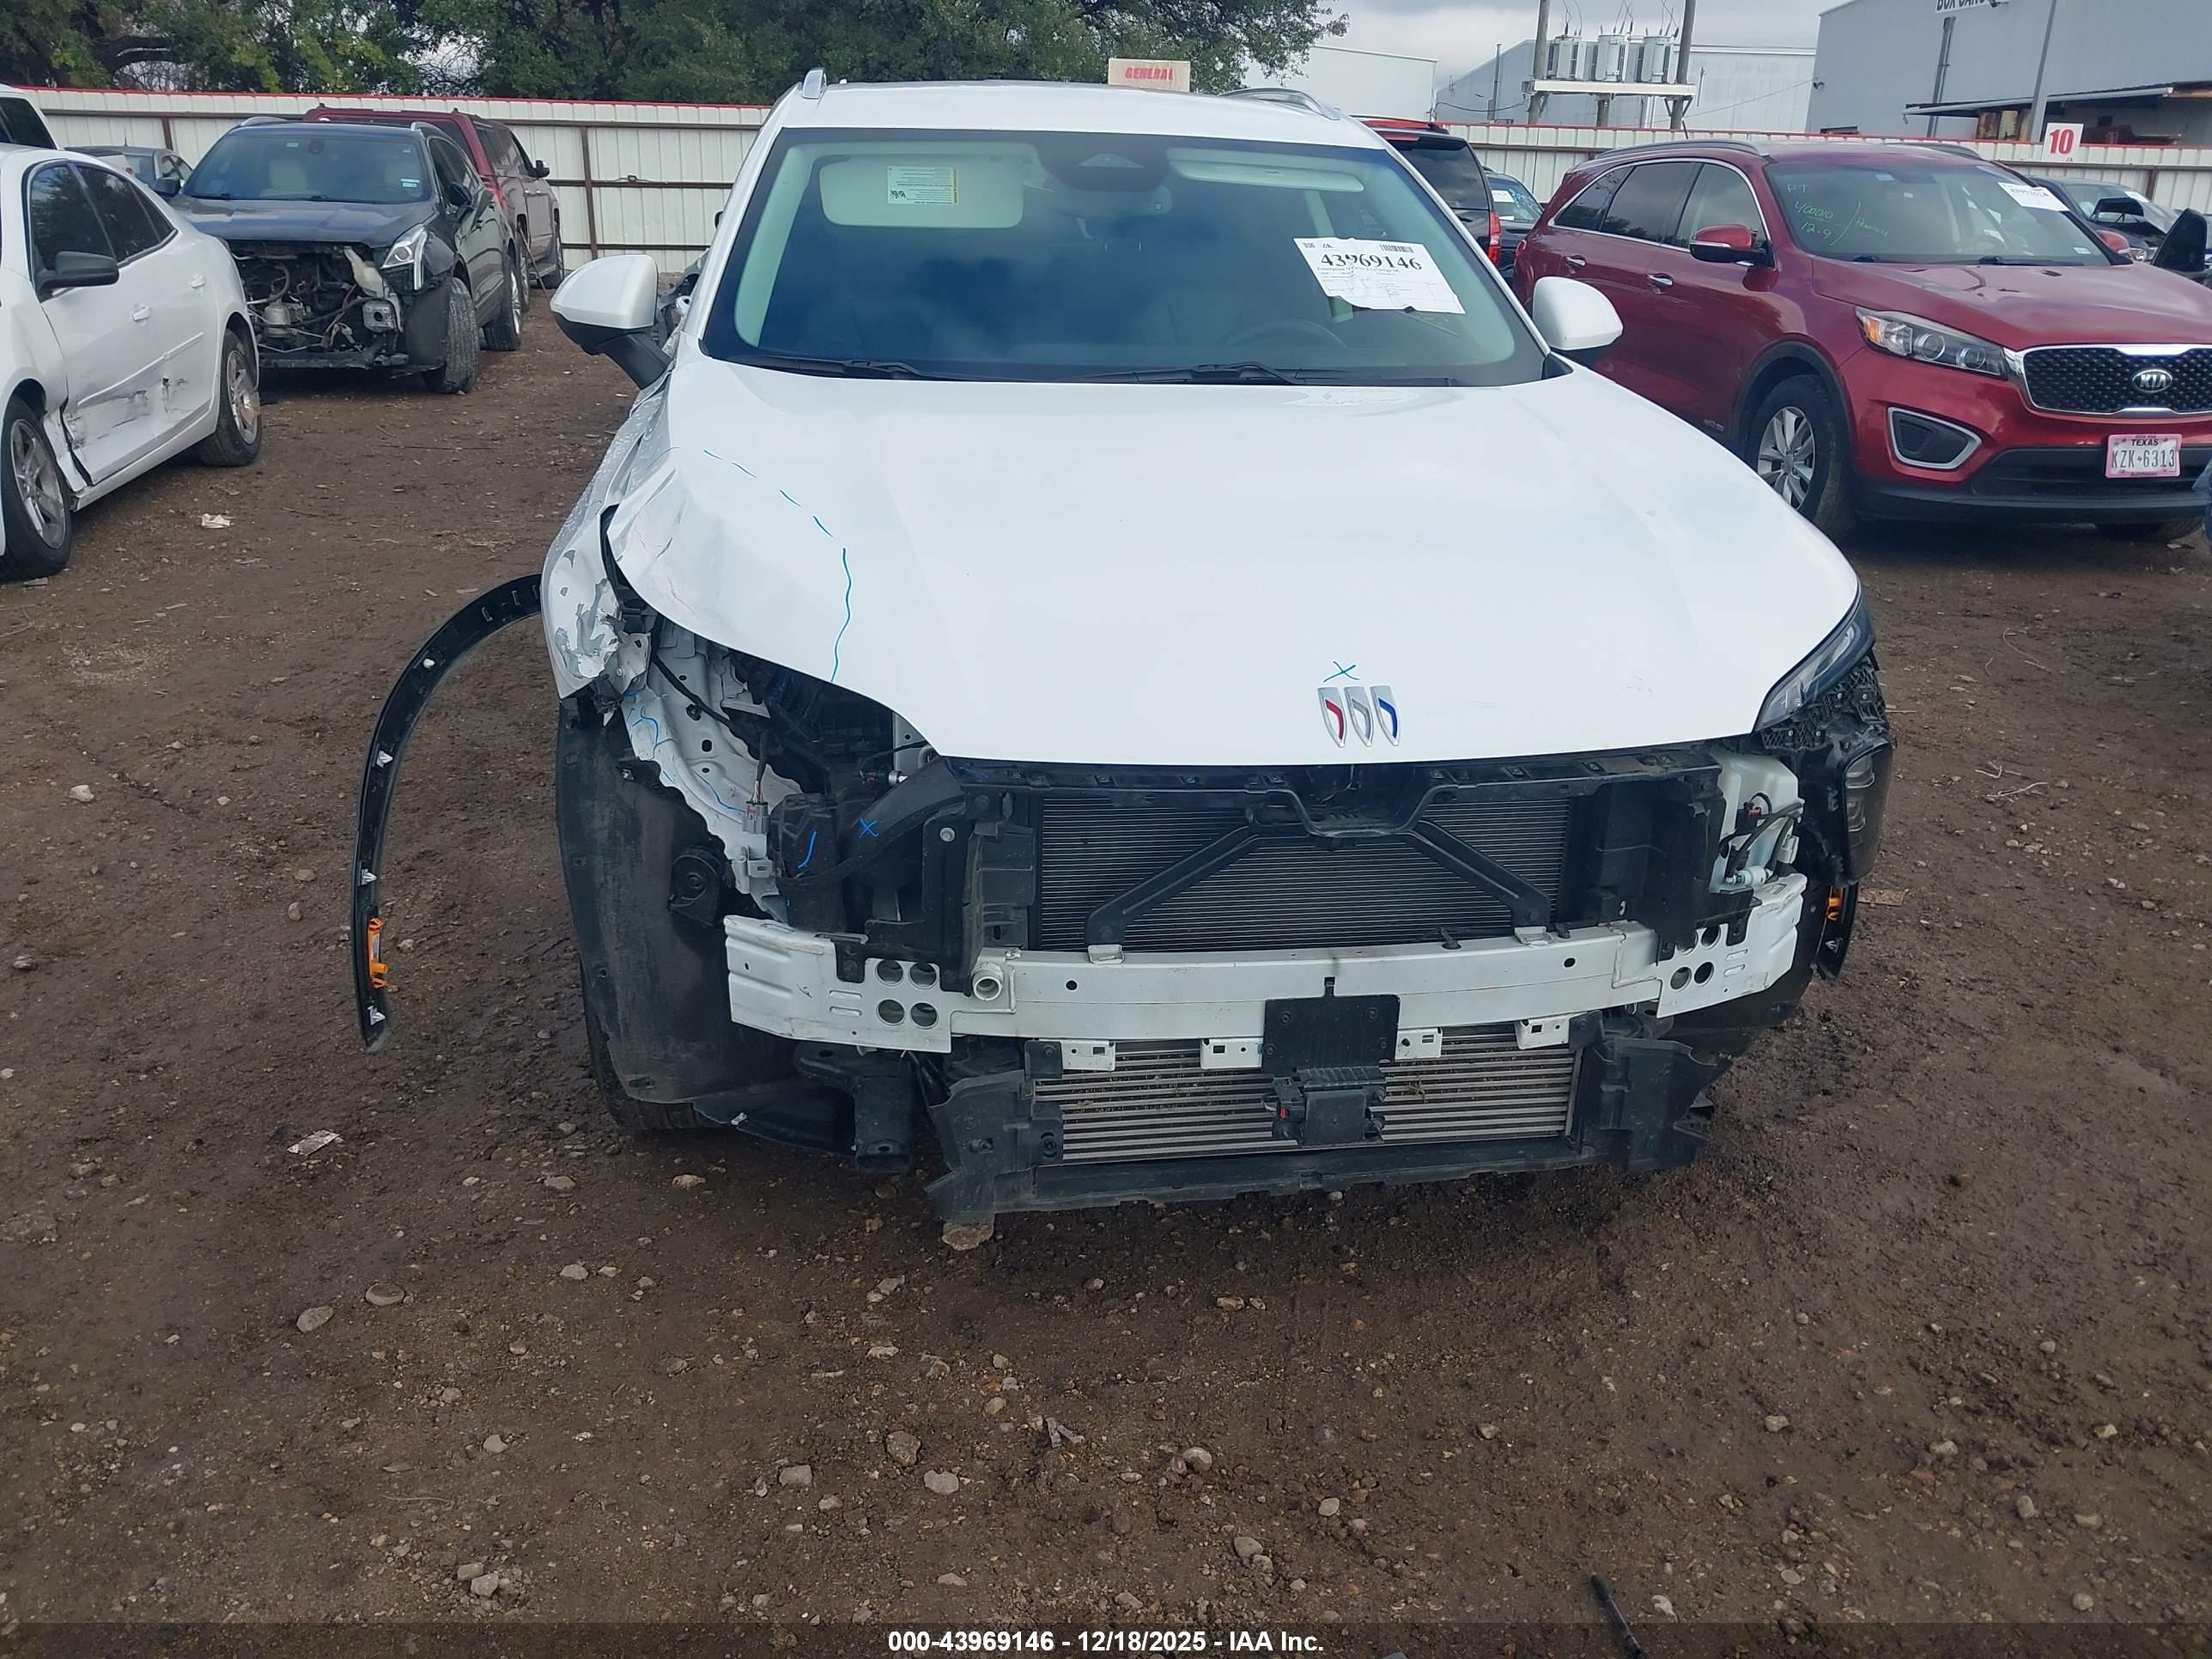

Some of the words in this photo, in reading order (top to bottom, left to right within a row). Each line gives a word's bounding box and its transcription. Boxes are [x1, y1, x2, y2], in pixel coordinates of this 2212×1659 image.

[1125, 67, 1174, 81] GENERAL
[2050, 129, 2074, 154] 10
[1321, 253, 1422, 270] 43969146
[2139, 374, 2166, 388] KIA
